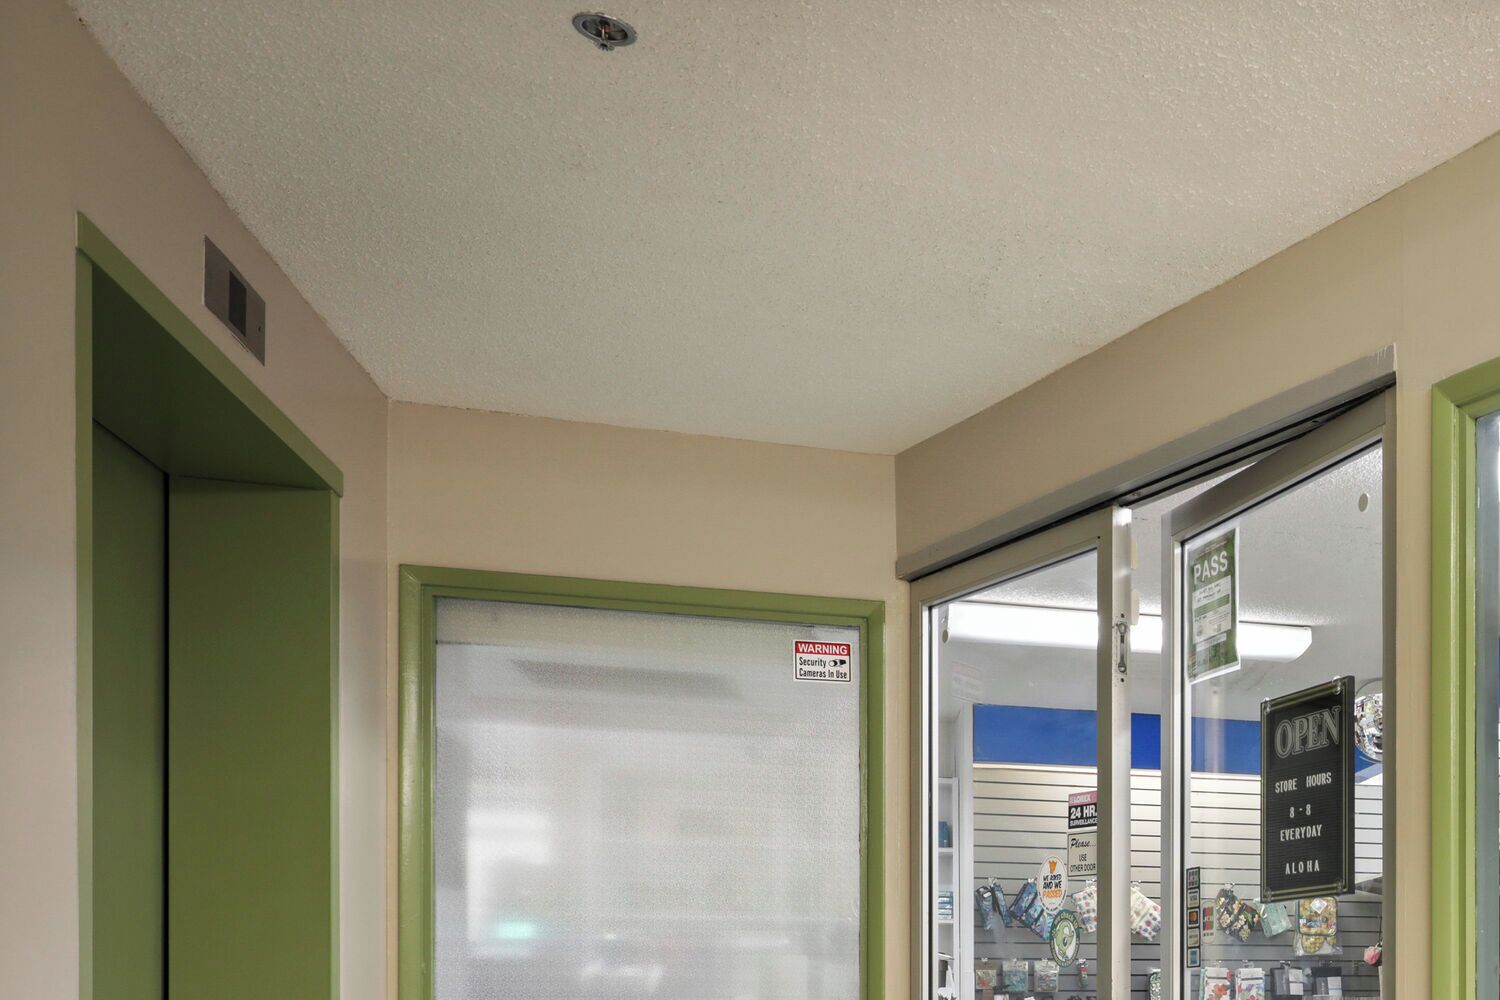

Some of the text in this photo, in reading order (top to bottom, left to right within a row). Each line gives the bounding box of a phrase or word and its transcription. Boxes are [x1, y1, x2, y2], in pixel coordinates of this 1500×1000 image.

[1193, 550, 1229, 585] PASS
[798, 643, 848, 655] WARNING
[799, 656, 827, 668] Security
[799, 668, 848, 679] Cameras In Use
[1275, 705, 1341, 759] OPEN
[1275, 772, 1332, 794] STORE HOURS
[1070, 807, 1081, 820] 24
[1289, 806, 1295, 819] 8
[1305, 804, 1311, 816] 8
[1070, 818, 1098, 827] SURVEILLANCE
[1280, 824, 1322, 842] EVERYDAY
[1079, 853, 1087, 862] USE
[1070, 863, 1096, 873] OTHER DOOR
[1285, 859, 1320, 876] ALOHA
[1043, 881, 1062, 890] AND WE
[1042, 889, 1062, 899] PASSED
